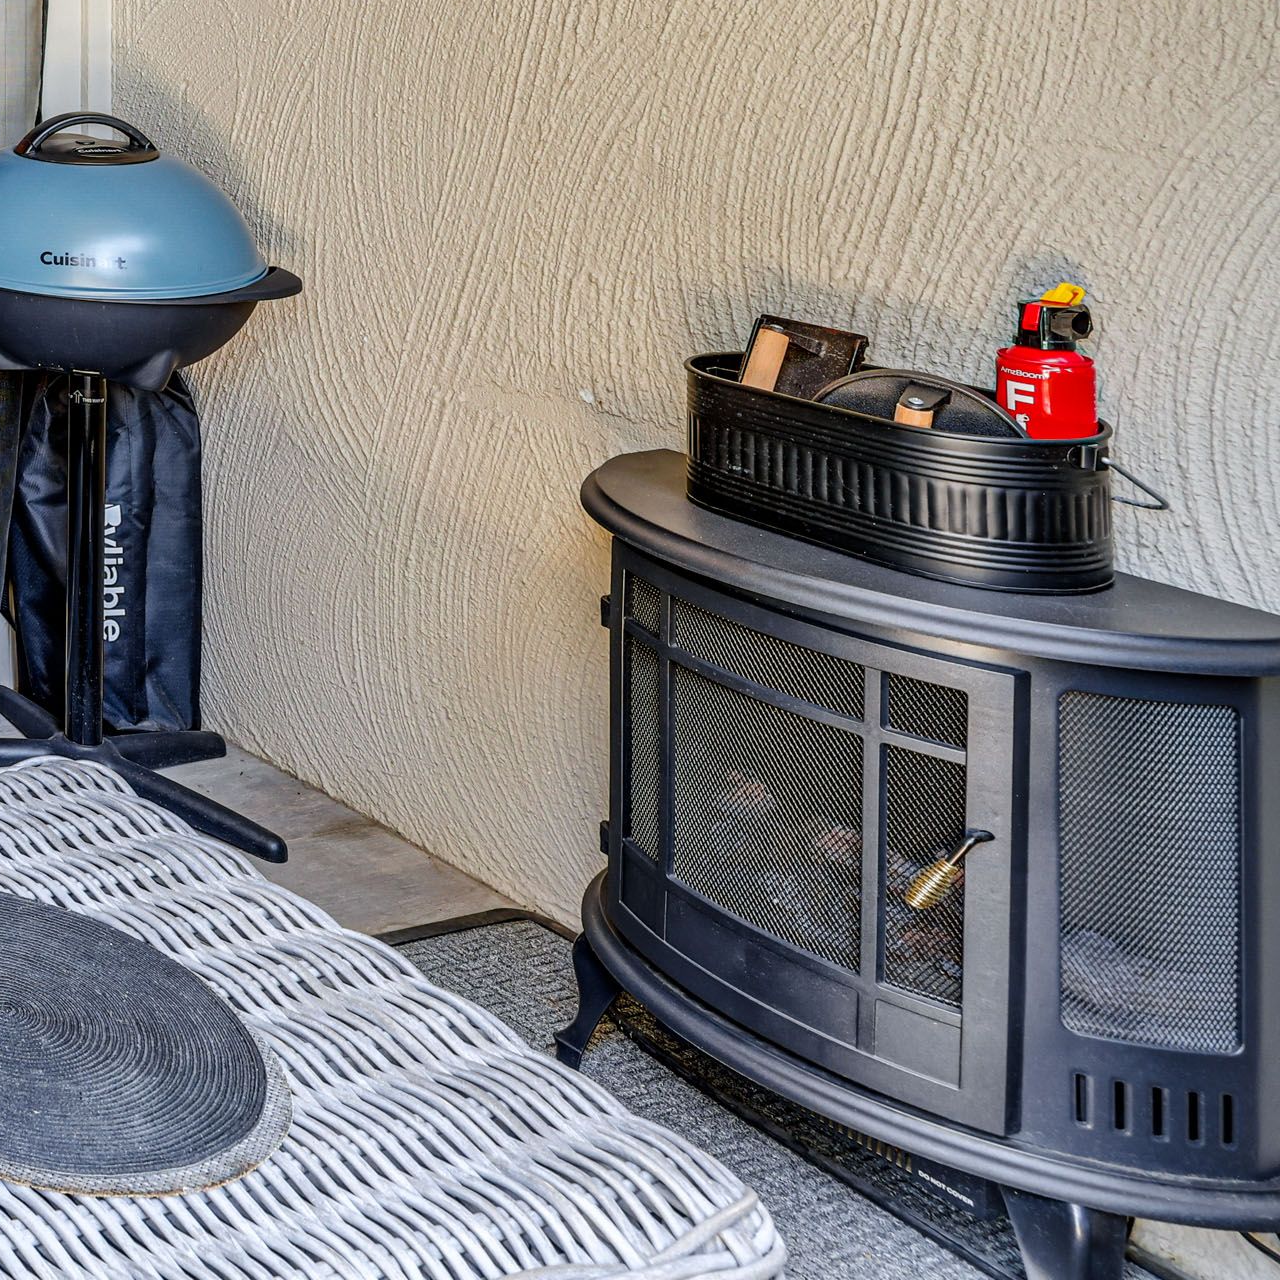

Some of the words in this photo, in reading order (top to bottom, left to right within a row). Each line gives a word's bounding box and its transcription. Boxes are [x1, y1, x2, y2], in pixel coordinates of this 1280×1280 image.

[39, 251, 127, 270] Cuisint
[1006, 379, 1035, 411] F
[918, 1169, 930, 1181] DO
[930, 1176, 947, 1191] NOT
[946, 1186, 975, 1208] COVER
